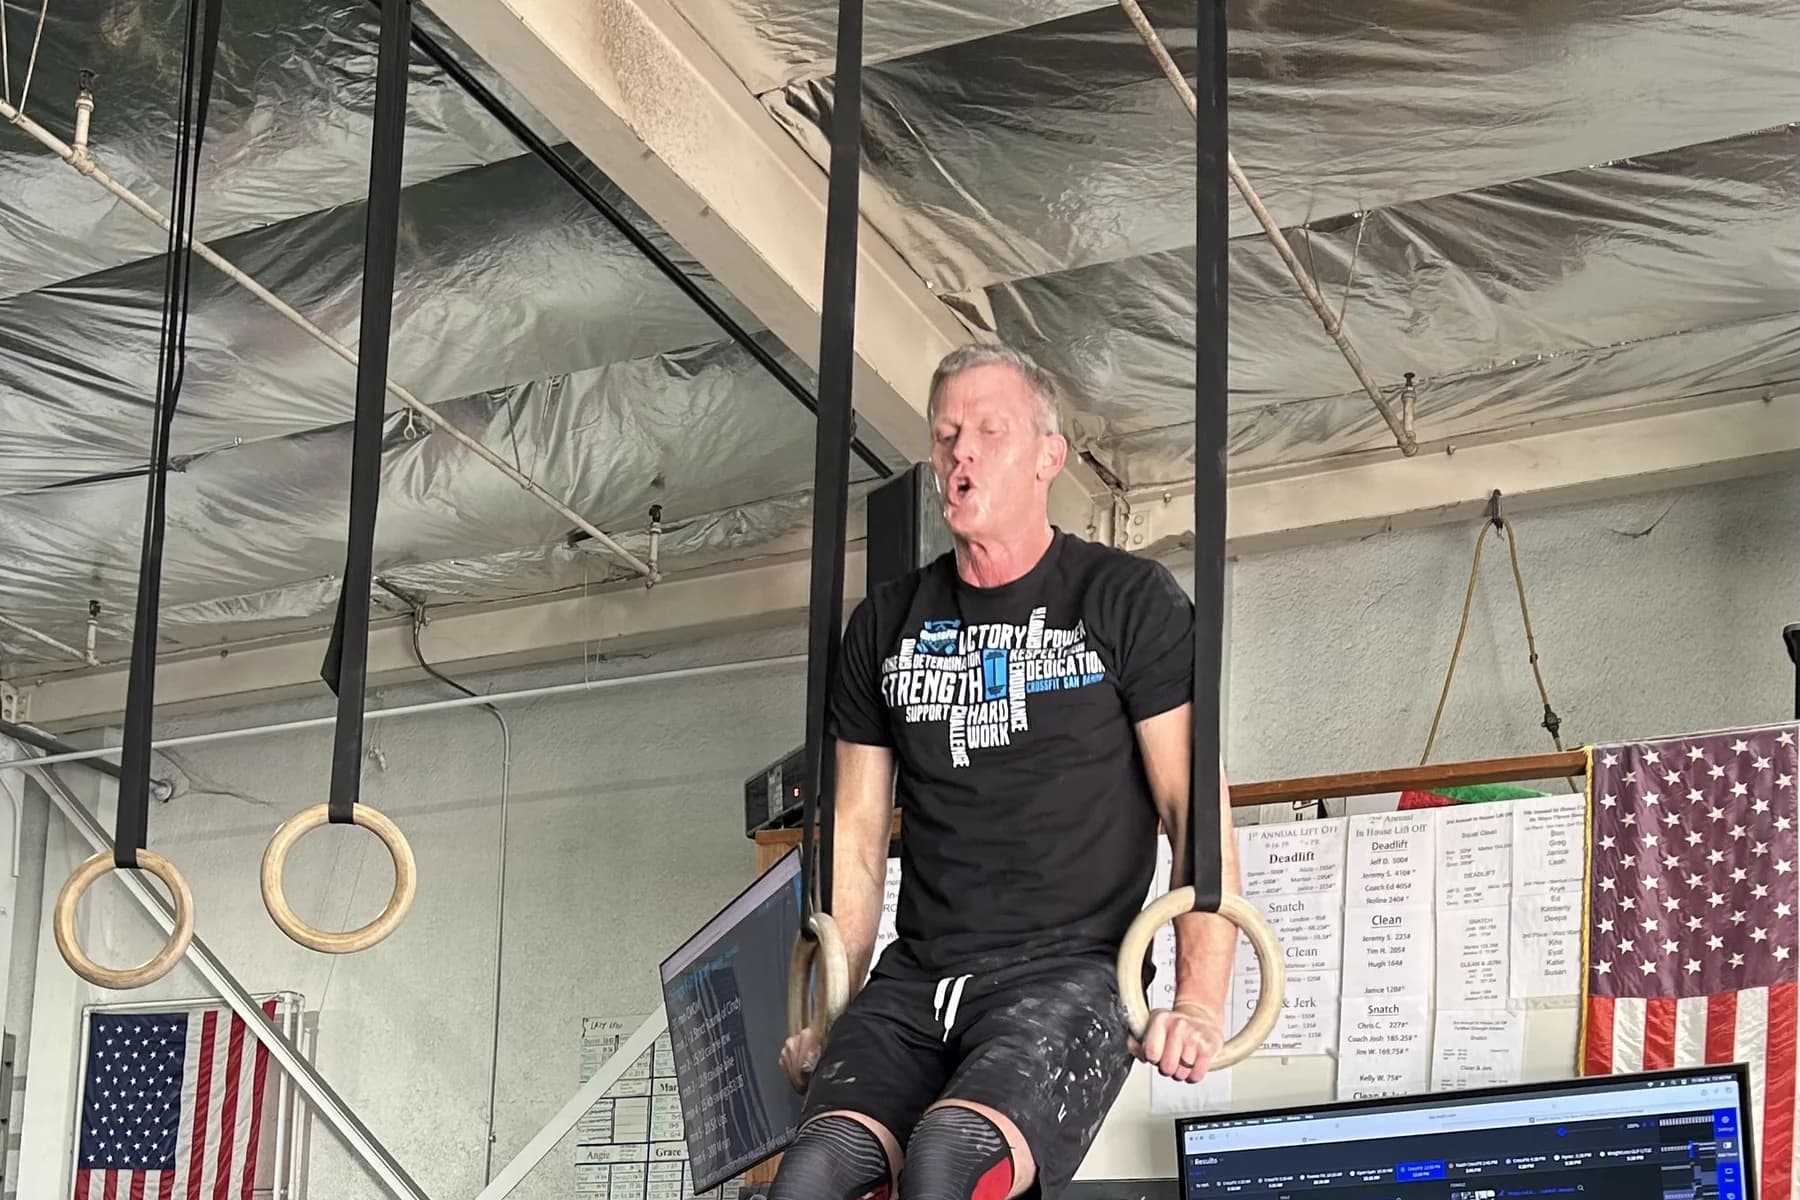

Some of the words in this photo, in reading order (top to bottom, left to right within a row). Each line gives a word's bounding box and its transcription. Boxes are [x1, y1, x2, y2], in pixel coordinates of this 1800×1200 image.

[1043, 618, 1086, 649] POWER
[1026, 650, 1106, 682] DEDICATION
[881, 667, 983, 708] STRENGTH
[1026, 677, 1060, 694] CROSSFIT
[1063, 675, 1080, 689] SAN
[1008, 661, 1029, 733] ENDURANCE
[905, 703, 950, 723] SUPPORT
[967, 699, 1009, 726] HARD
[966, 721, 1011, 750] WORK
[1261, 830, 1297, 840] ANNUAL
[1300, 827, 1319, 836] LIFT
[1366, 827, 1393, 837] House
[1371, 840, 1409, 851] Deadlift
[1269, 851, 1315, 865] Deadlift
[1364, 884, 1385, 892] Coach
[1268, 901, 1305, 914] Snatch
[1371, 915, 1403, 926] Clean
[1286, 947, 1318, 958] Clean
[726, 997, 741, 1016] Cindy
[1294, 997, 1317, 1009] Jerk
[1368, 1004, 1400, 1014] Snatch
[1360, 1074, 1376, 1082] Kelly
[586, 1151, 610, 1162] Angie
[655, 1147, 682, 1157] Grace
